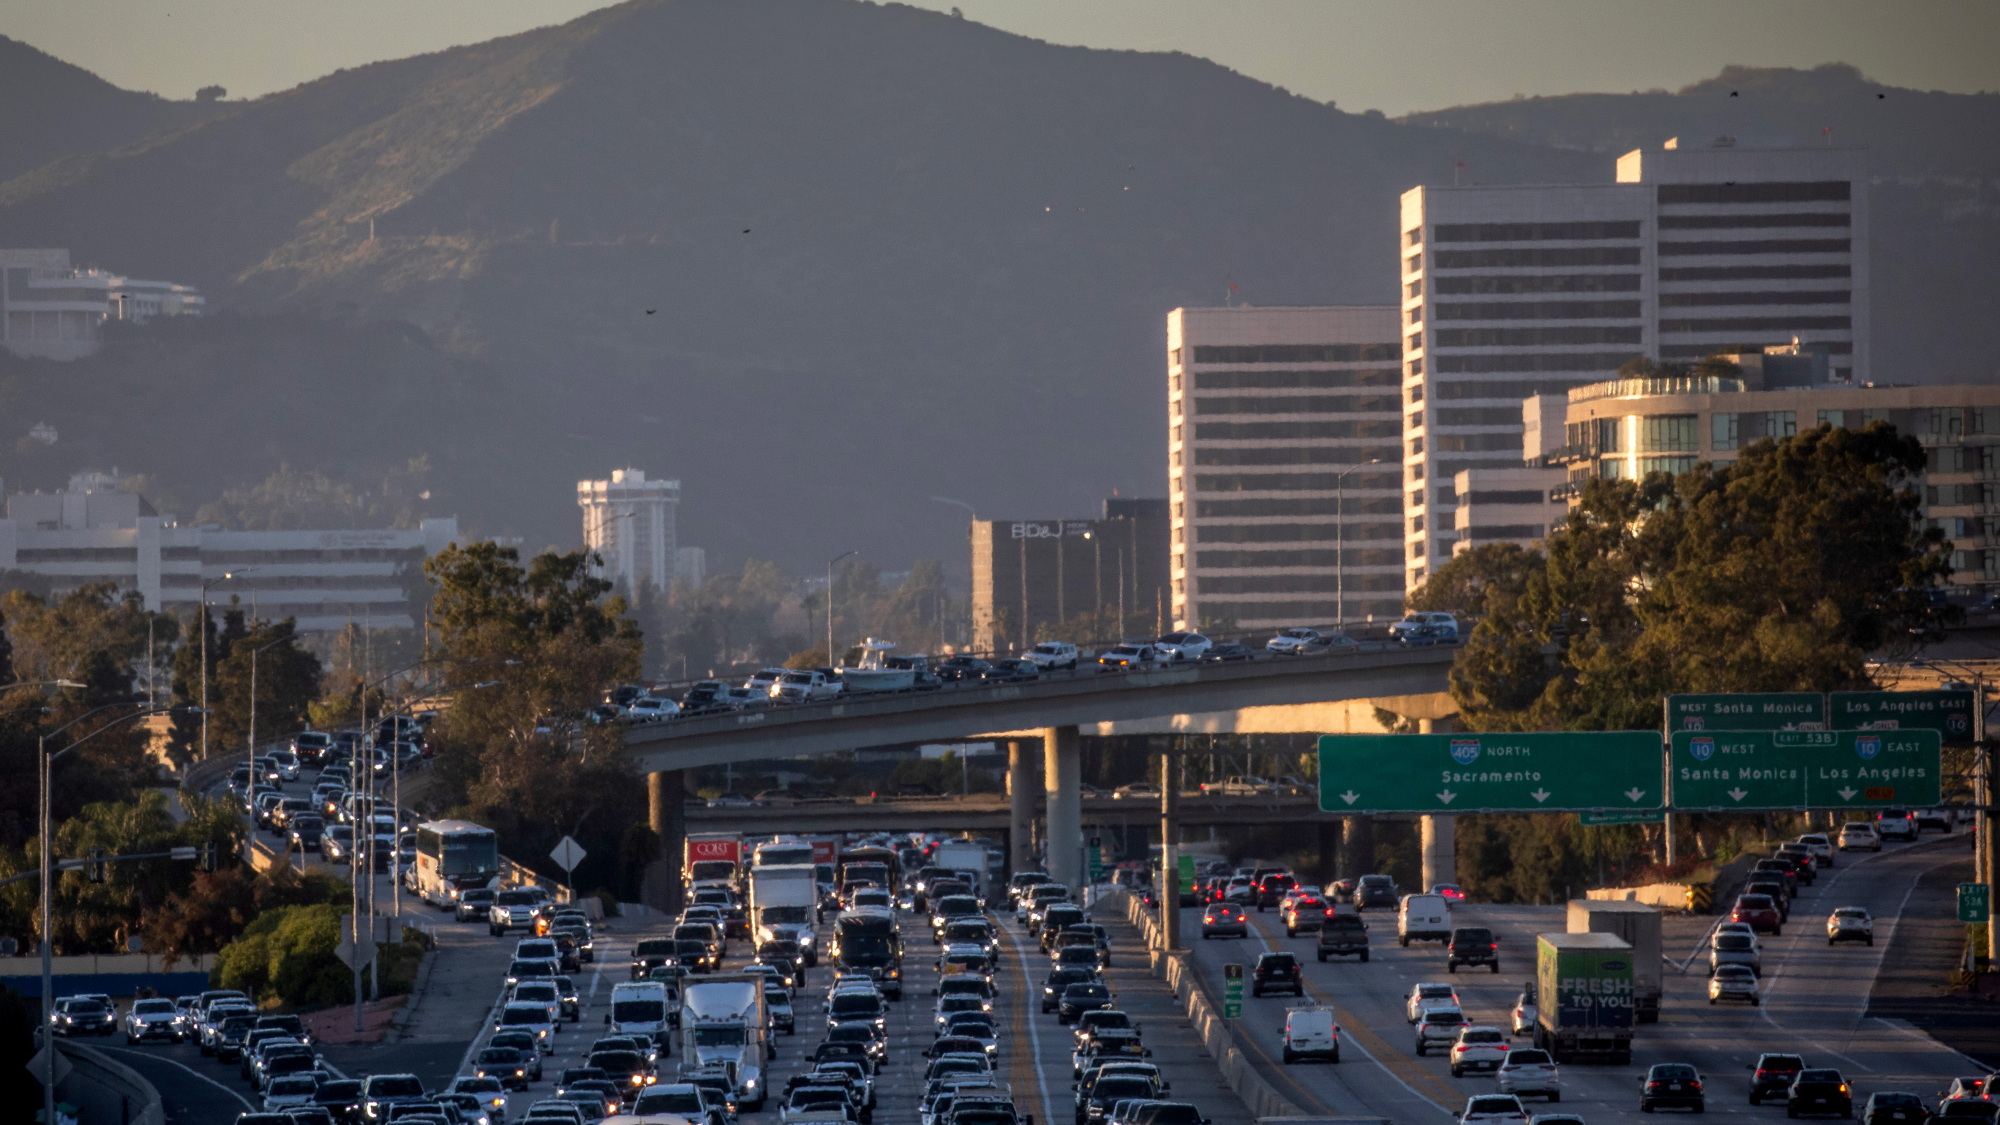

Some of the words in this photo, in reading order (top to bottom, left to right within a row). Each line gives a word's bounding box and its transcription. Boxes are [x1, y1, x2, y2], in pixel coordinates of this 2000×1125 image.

[1011, 523, 1063, 538] BD&J
[1680, 703, 1706, 712] WEST
[1714, 702, 1753, 714] Santa
[1763, 702, 1813, 713] Monica
[1847, 701, 1870, 713] Los
[1880, 701, 1934, 714] Angeles
[1940, 700, 1966, 709] EAST
[1951, 720, 1967, 731] 10
[1779, 734, 1801, 743] EXIT
[1806, 733, 1832, 744] 53B
[1454, 746, 1478, 759] 405
[1486, 746, 1531, 757] NORTH
[1696, 745, 1710, 756] 10
[1721, 744, 1756, 754] WEST
[1861, 742, 1875, 755] 10
[1887, 742, 1920, 752] EAST
[1442, 770, 1541, 783] Sacramento
[1680, 767, 1730, 780] Santa
[1739, 766, 1797, 779] Monica
[1820, 767, 1849, 779] Los
[1857, 766, 1926, 782] Angeles
[697, 842, 729, 855] CORT
[1961, 886, 1986, 894] EXIT
[1562, 977, 1630, 994] FRESH
[1572, 995, 1593, 1008] TO
[1598, 996, 1631, 1009] YOU
